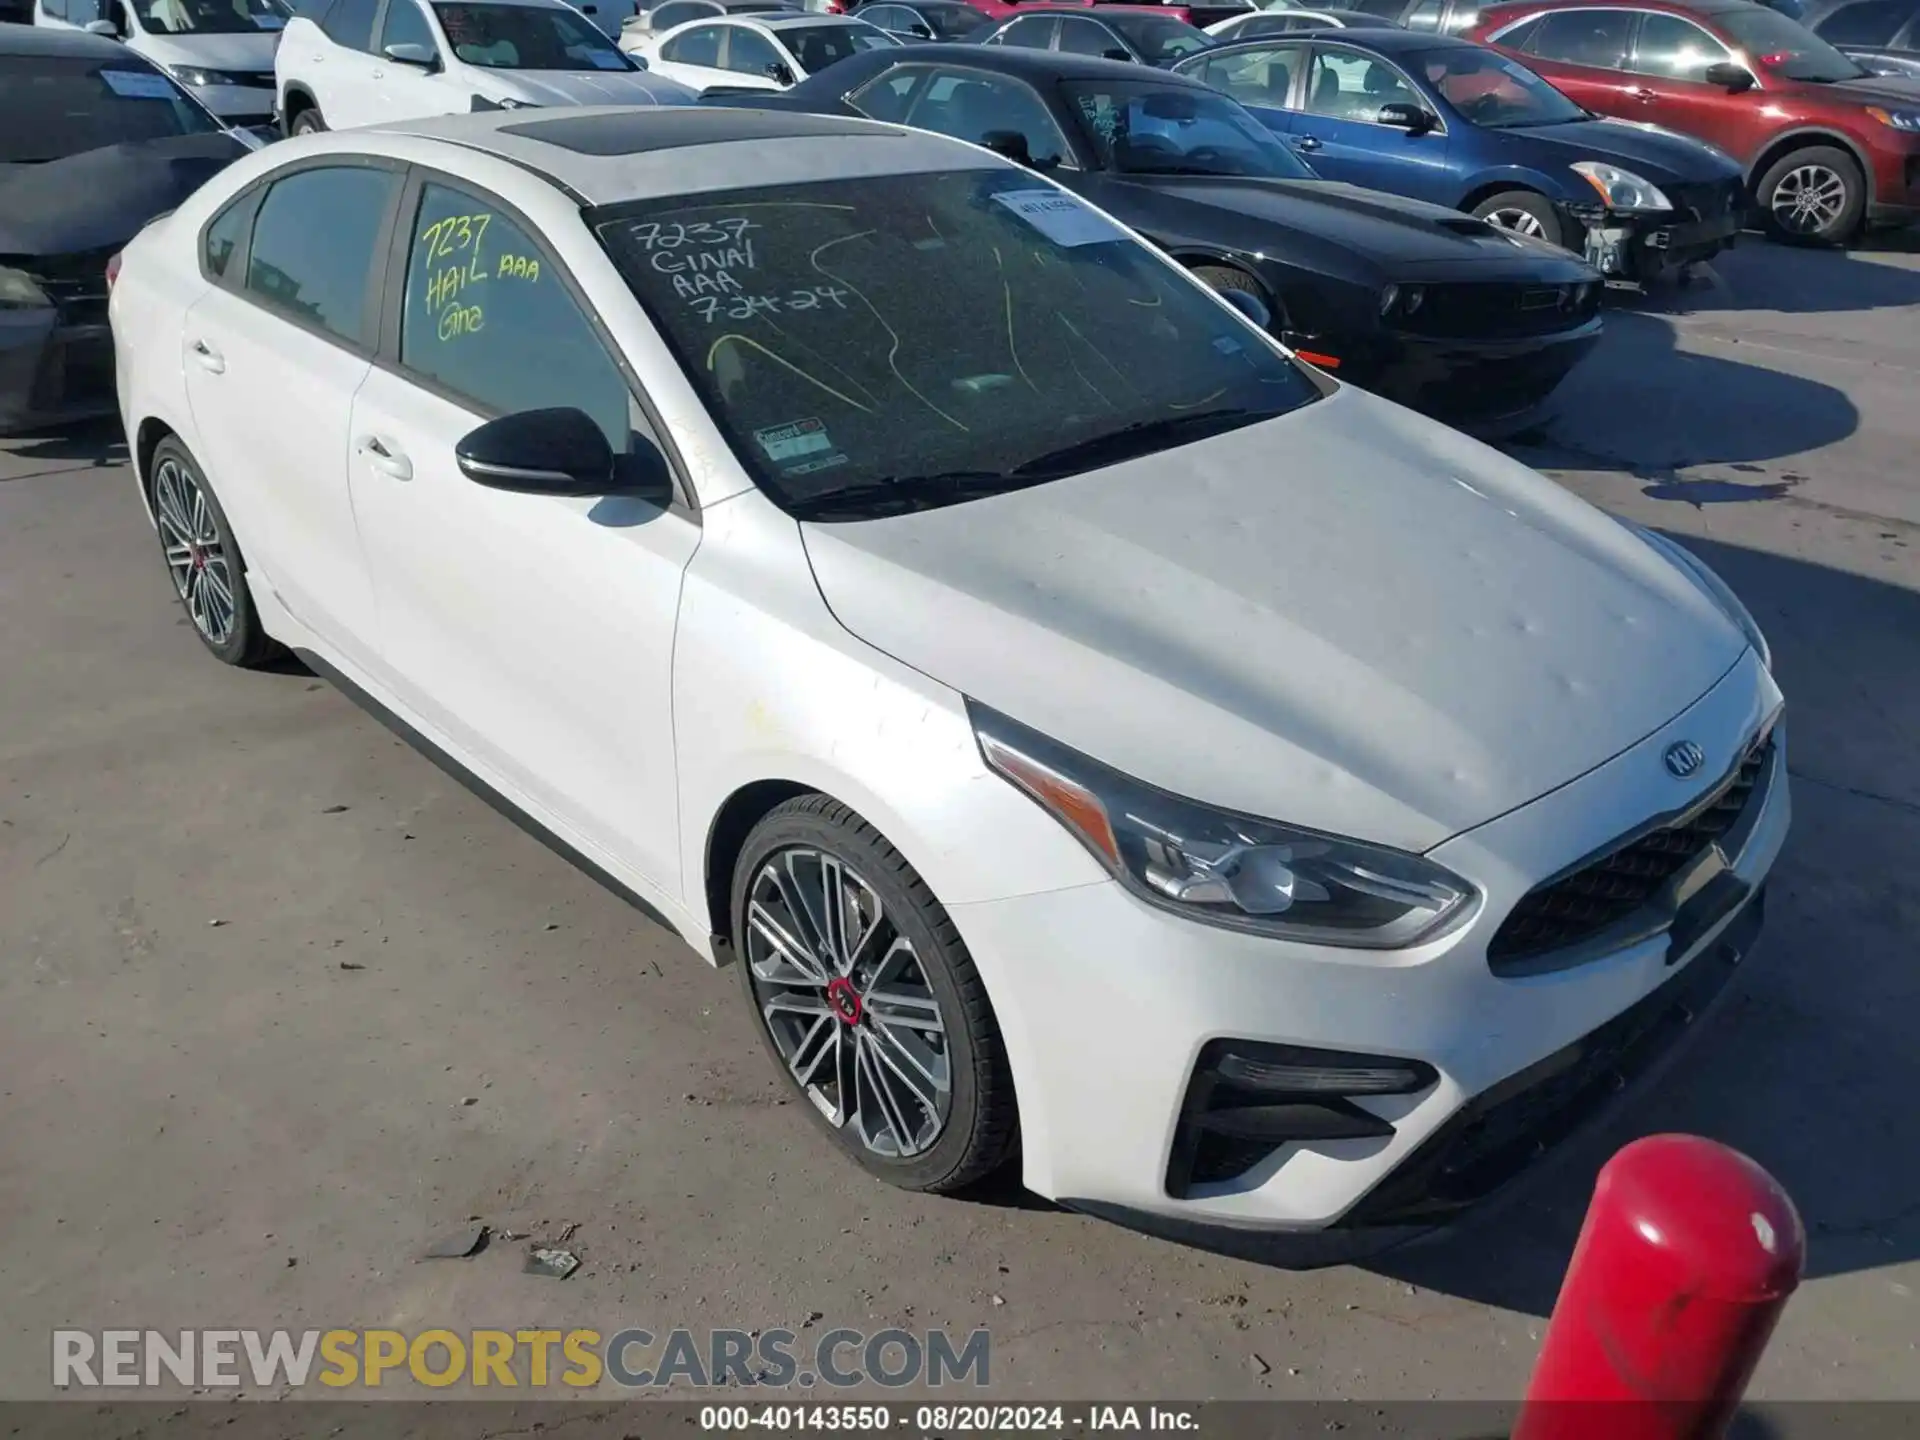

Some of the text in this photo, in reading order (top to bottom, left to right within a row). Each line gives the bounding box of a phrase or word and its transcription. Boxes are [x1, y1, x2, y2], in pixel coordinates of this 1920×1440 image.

[423, 213, 491, 269] 7237
[629, 217, 762, 250] 7237
[425, 253, 540, 316] HAIL AAA
[672, 269, 744, 298] AAA
